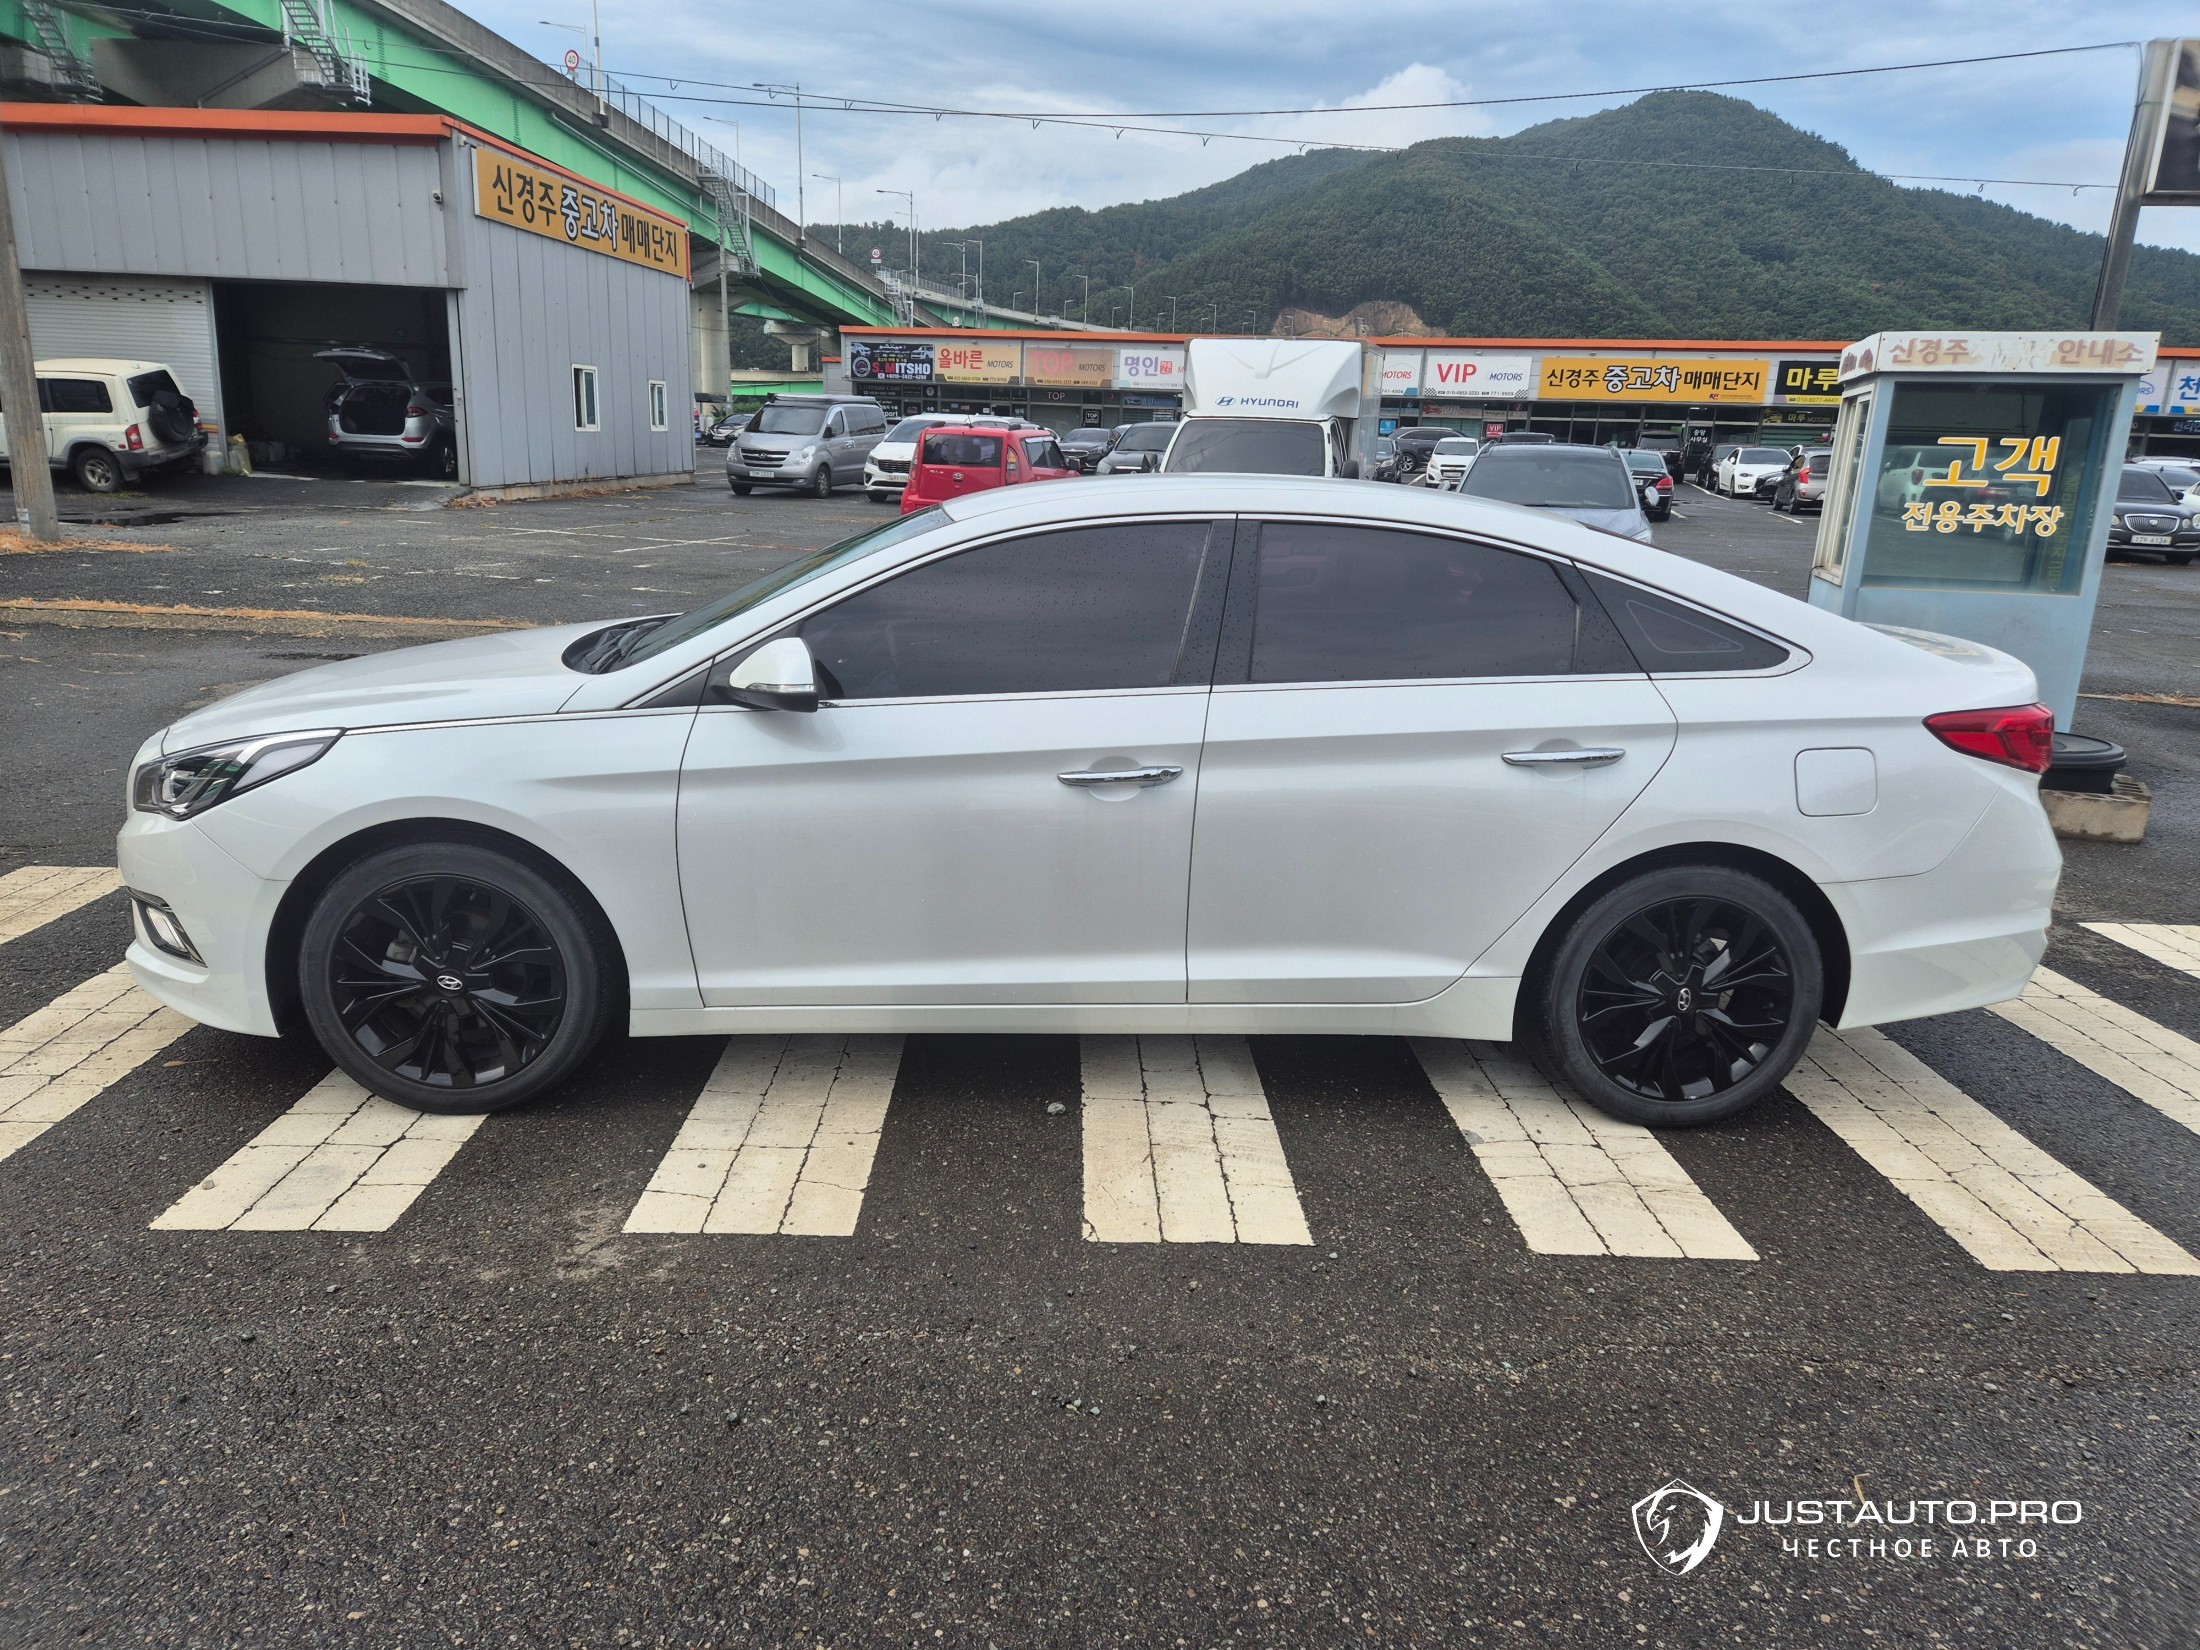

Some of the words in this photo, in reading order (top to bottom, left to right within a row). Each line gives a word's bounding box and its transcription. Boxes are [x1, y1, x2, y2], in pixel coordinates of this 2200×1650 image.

[568, 55, 576, 64] 40
[492, 165, 557, 226] 신경주
[560, 184, 618, 252] 중고차
[621, 213, 678, 267] 매매단지
[938, 348, 983, 370] 올바른
[987, 360, 1014, 369] MOTORS
[1031, 351, 1073, 374] TOP
[1078, 363, 1106, 372] MOTORS
[1889, 338, 1969, 365] 신경주
[2057, 338, 2144, 365] 안내소
[1124, 356, 1158, 377] 명인
[1437, 363, 1477, 383] VIP
[1489, 373, 1523, 381] MOTORS
[1547, 368, 1600, 388] 신경주
[1603, 365, 1682, 393] 중고차
[1683, 370, 1760, 391] 매매단지
[1786, 367, 1839, 391] 마루
[1047, 391, 1066, 400] TOP
[1241, 397, 1299, 409] HYUNDAI
[1922, 435, 2061, 497] 고객
[1901, 500, 2065, 537] 전용주차장
